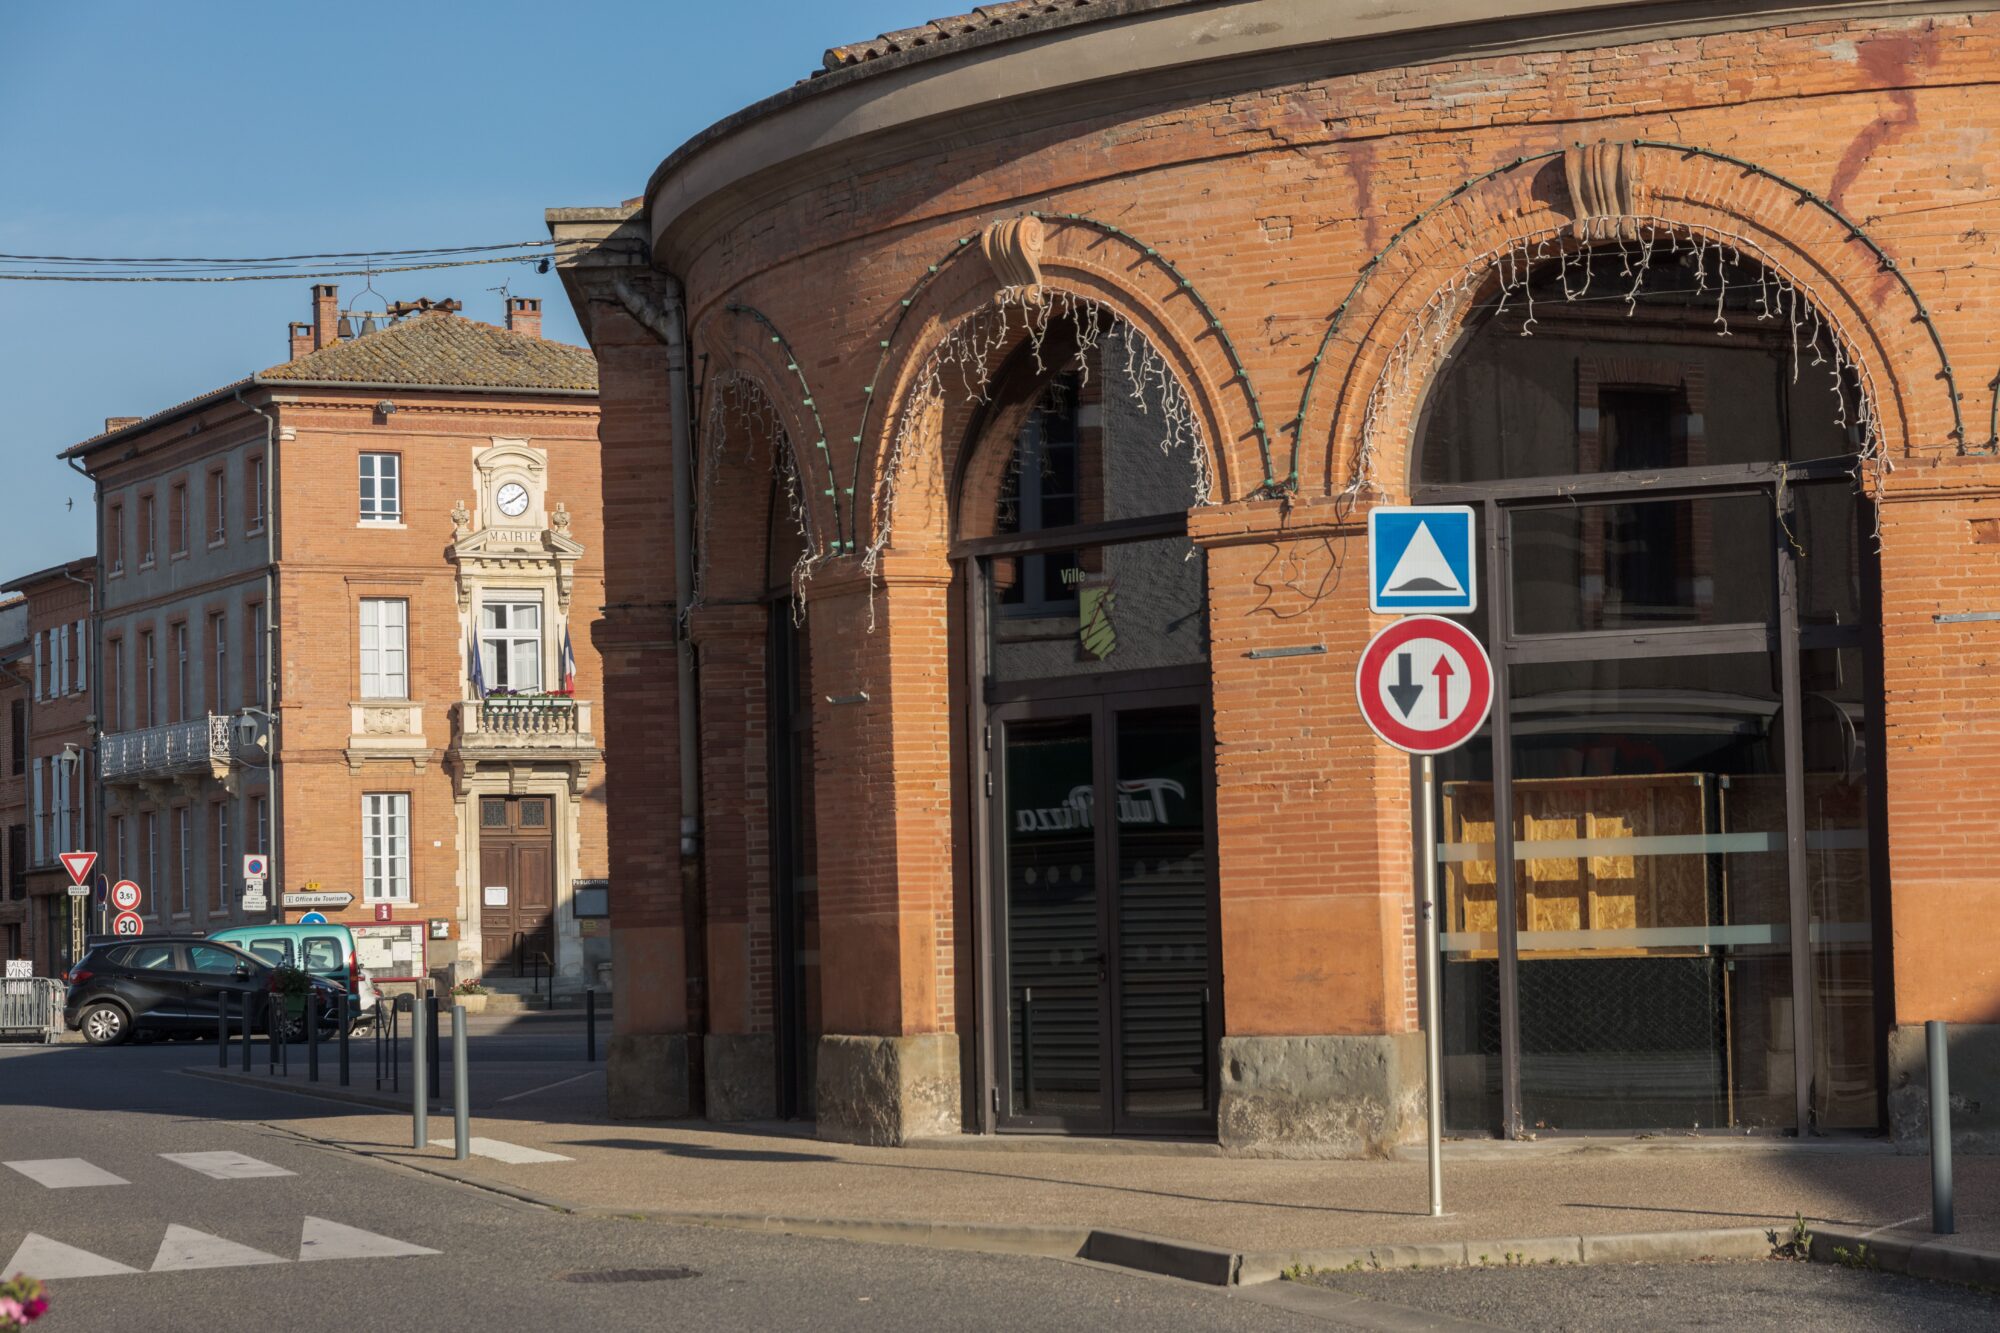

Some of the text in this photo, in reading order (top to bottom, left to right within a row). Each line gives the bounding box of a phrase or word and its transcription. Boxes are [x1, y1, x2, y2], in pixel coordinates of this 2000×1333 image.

[490, 531, 537, 543] MAIRIE
[1060, 567, 1086, 585] Ville
[295, 895, 313, 903] Office
[322, 894, 348, 902] Tourisme
[119, 920, 137, 934] 30
[7, 967, 33, 977] VINS
